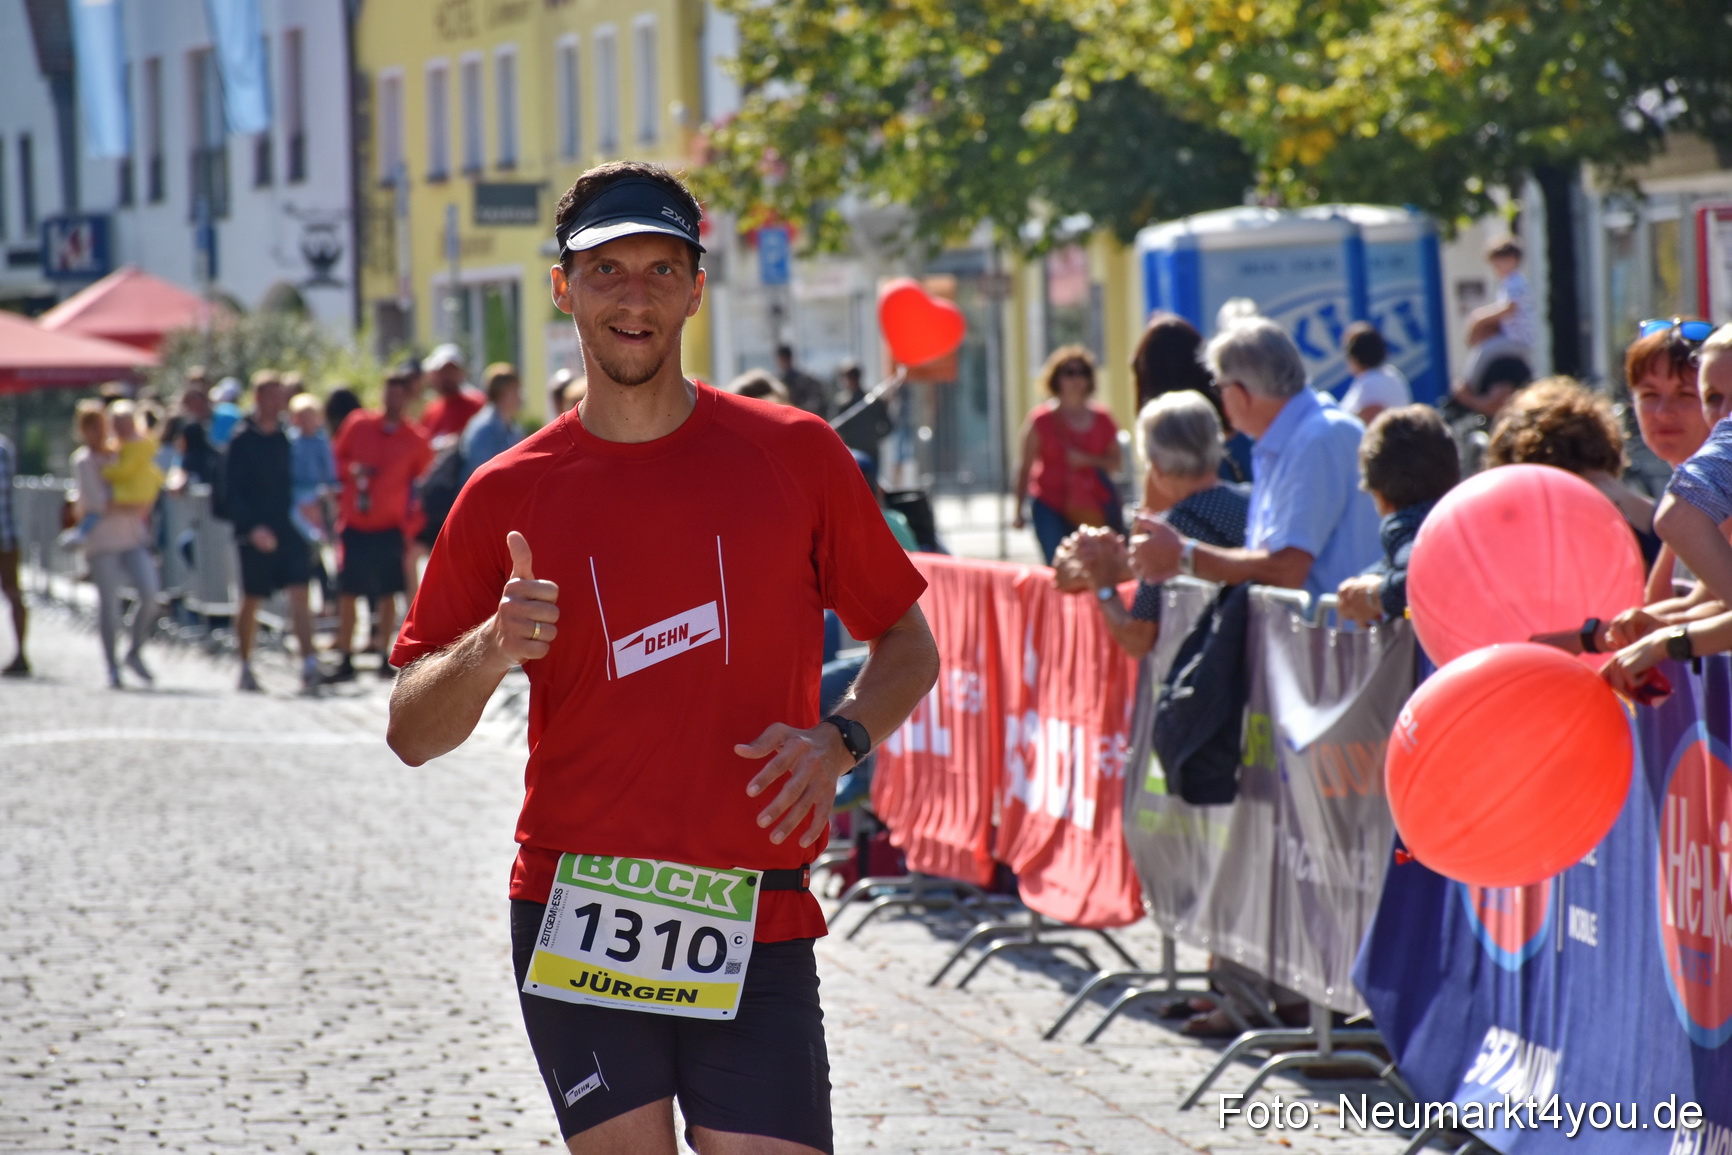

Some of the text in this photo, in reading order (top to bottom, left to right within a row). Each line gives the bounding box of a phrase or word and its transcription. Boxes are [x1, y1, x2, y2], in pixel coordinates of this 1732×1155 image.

[645, 622, 689, 656] DEHN
[573, 851, 741, 913] BOCK
[575, 902, 728, 974] 1310
[569, 971, 699, 1003] JÜRGEN
[573, 1082, 590, 1098] DEHN
